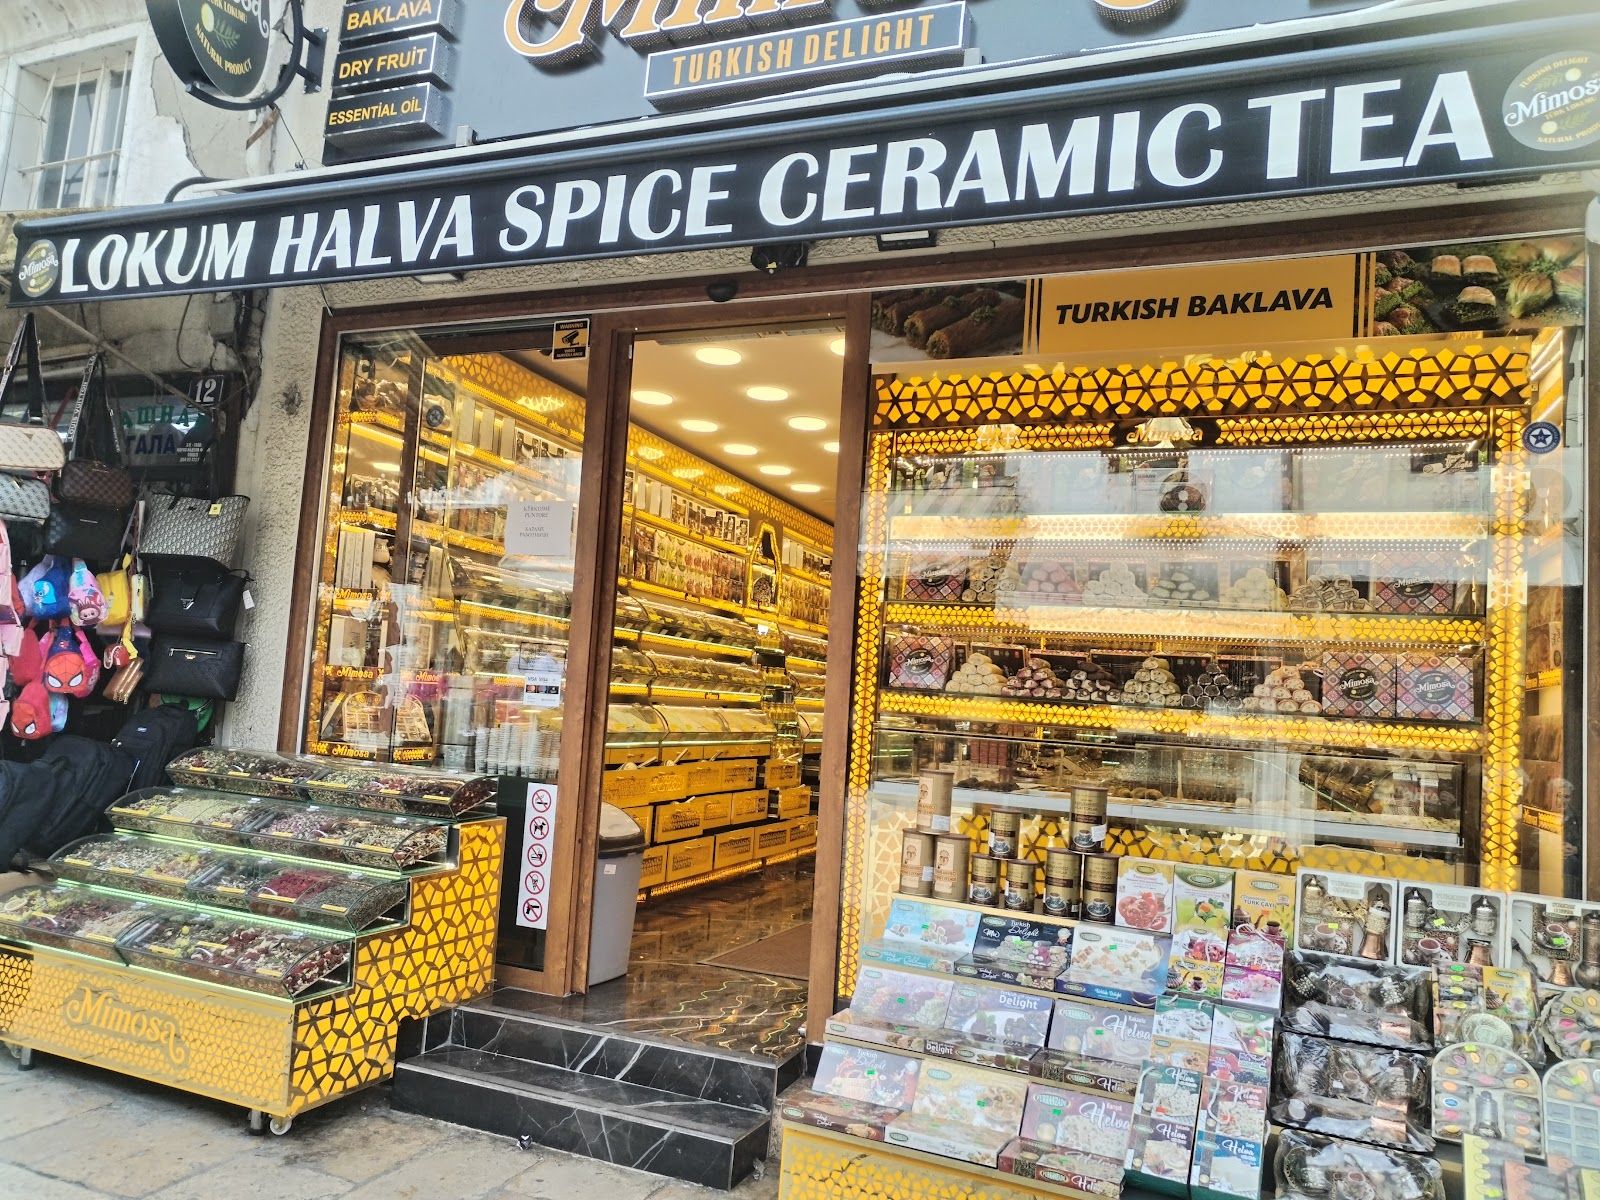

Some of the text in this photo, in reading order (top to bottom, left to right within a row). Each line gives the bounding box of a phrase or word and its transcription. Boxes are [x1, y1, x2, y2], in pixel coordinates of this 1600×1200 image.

[347, 0, 432, 31] BAKLAVA
[194, 23, 252, 75] NATURAL PRODUCT
[671, 41, 792, 87] TURKISH
[802, 14, 936, 65] DELIGHT
[339, 58, 374, 79] DRY
[1503, 78, 1600, 127] Mimos
[60, 70, 1494, 294] LOKUM HALVA SPICE CERAMIC TEA
[19, 254, 59, 280] Mimosa
[1056, 286, 1334, 325] TURKISH BAKLAVA
[195, 378, 217, 403] 12
[337, 667, 374, 679] Mimosa
[1339, 677, 1379, 690] Mimosa
[1415, 680, 1456, 693] Mimosa
[332, 745, 370, 758] Mimosa
[1008, 925, 1040, 939] Delight
[999, 994, 1038, 1010] Delight
[67, 986, 185, 1065] Mimosa
[926, 1043, 953, 1055] Delight
